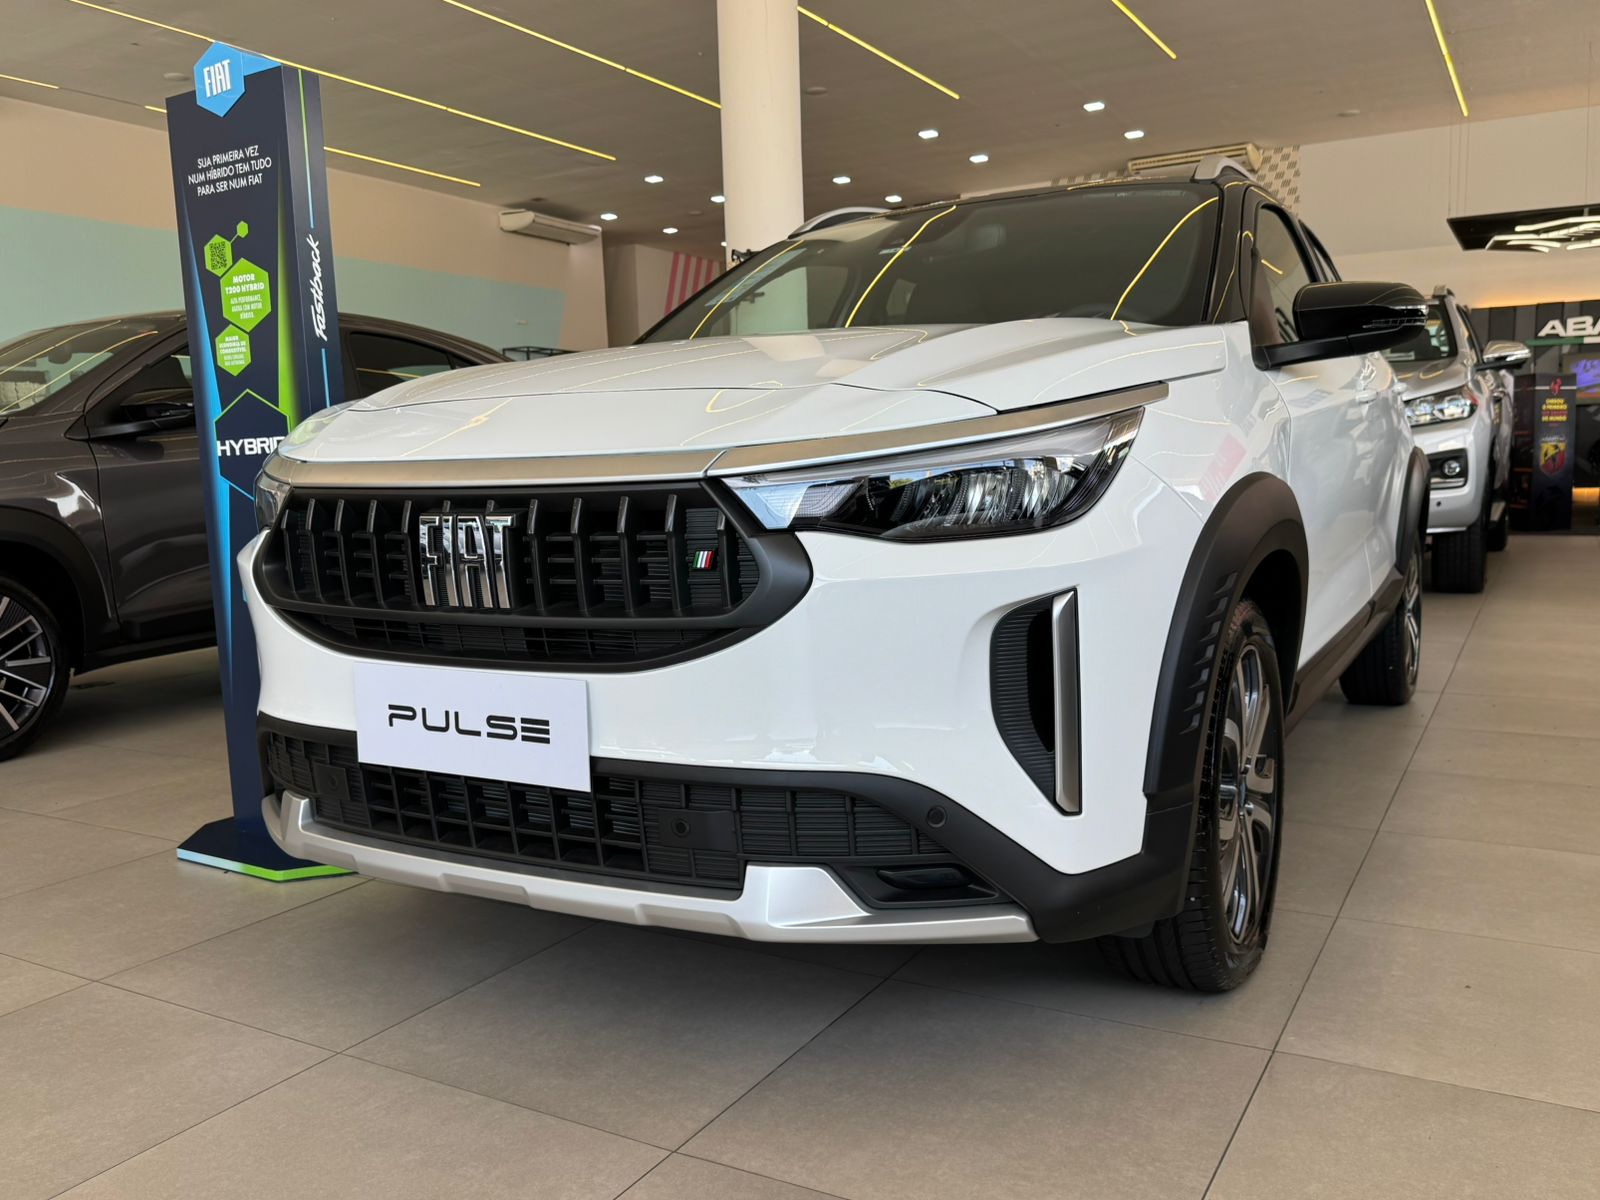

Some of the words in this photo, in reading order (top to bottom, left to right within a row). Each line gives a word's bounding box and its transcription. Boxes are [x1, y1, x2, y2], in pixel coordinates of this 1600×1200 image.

[203, 59, 231, 98] FIAT
[188, 173, 206, 184] NUM
[206, 167, 235, 183] HÍBRIDO
[235, 162, 251, 174] TEM
[251, 157, 272, 171] TUDO
[197, 158, 212, 169] SUA
[212, 149, 244, 165] PRIMEIRA
[245, 145, 259, 157] VEZ
[197, 184, 216, 196] PARA
[216, 181, 229, 192] SER
[229, 176, 248, 189] NUM
[248, 173, 263, 184] FIAT
[225, 284, 241, 295] T200
[241, 282, 265, 293] HYBRID
[233, 273, 255, 283] MOTOR
[306, 234, 328, 342] Fastback
[419, 515, 515, 609] FIAT
[388, 704, 550, 744] PULSE
